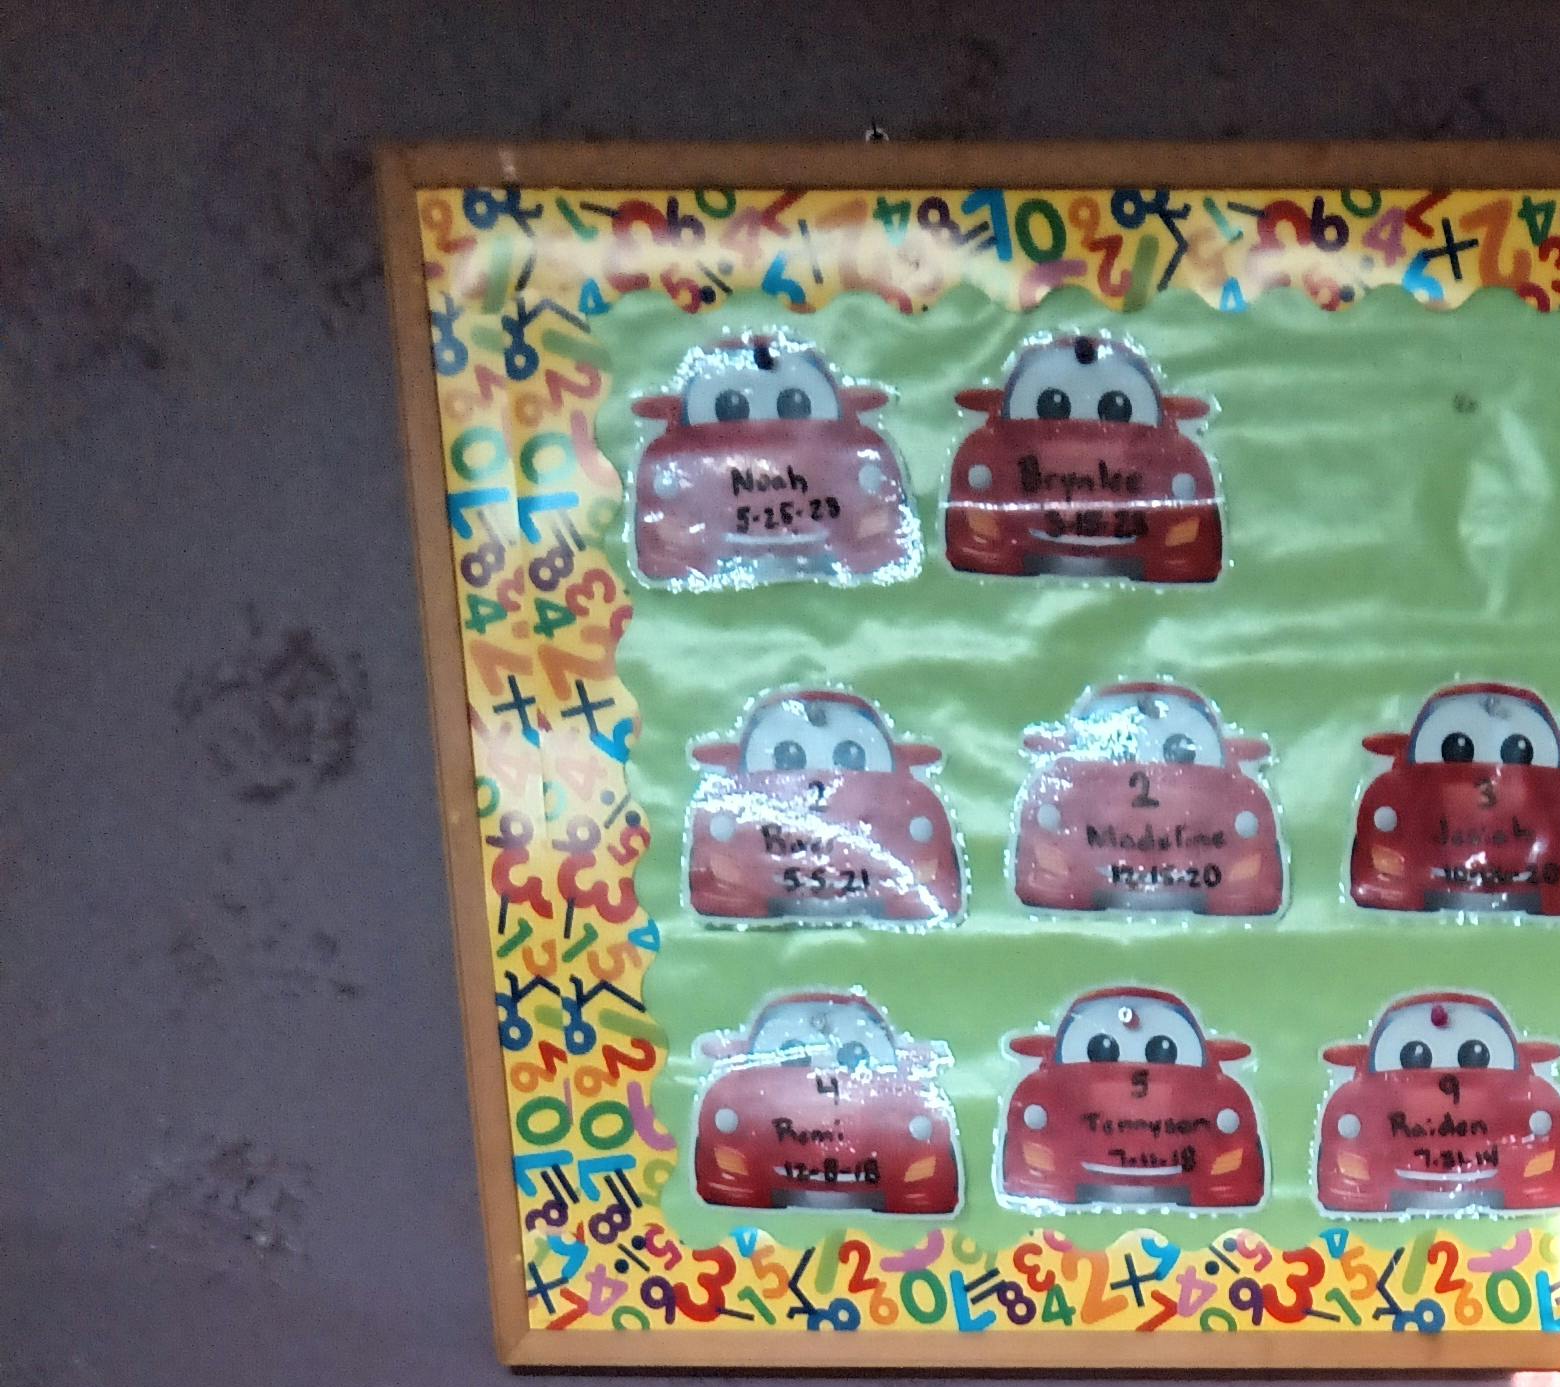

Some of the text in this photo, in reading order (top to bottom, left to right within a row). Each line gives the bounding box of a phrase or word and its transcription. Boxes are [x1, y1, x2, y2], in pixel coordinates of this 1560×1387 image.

[1129, 771, 1160, 808] 2
[816, 1075, 840, 1106] 4
[1438, 1073, 1461, 1105] 9
[1388, 1111, 1489, 1138] Raiden
